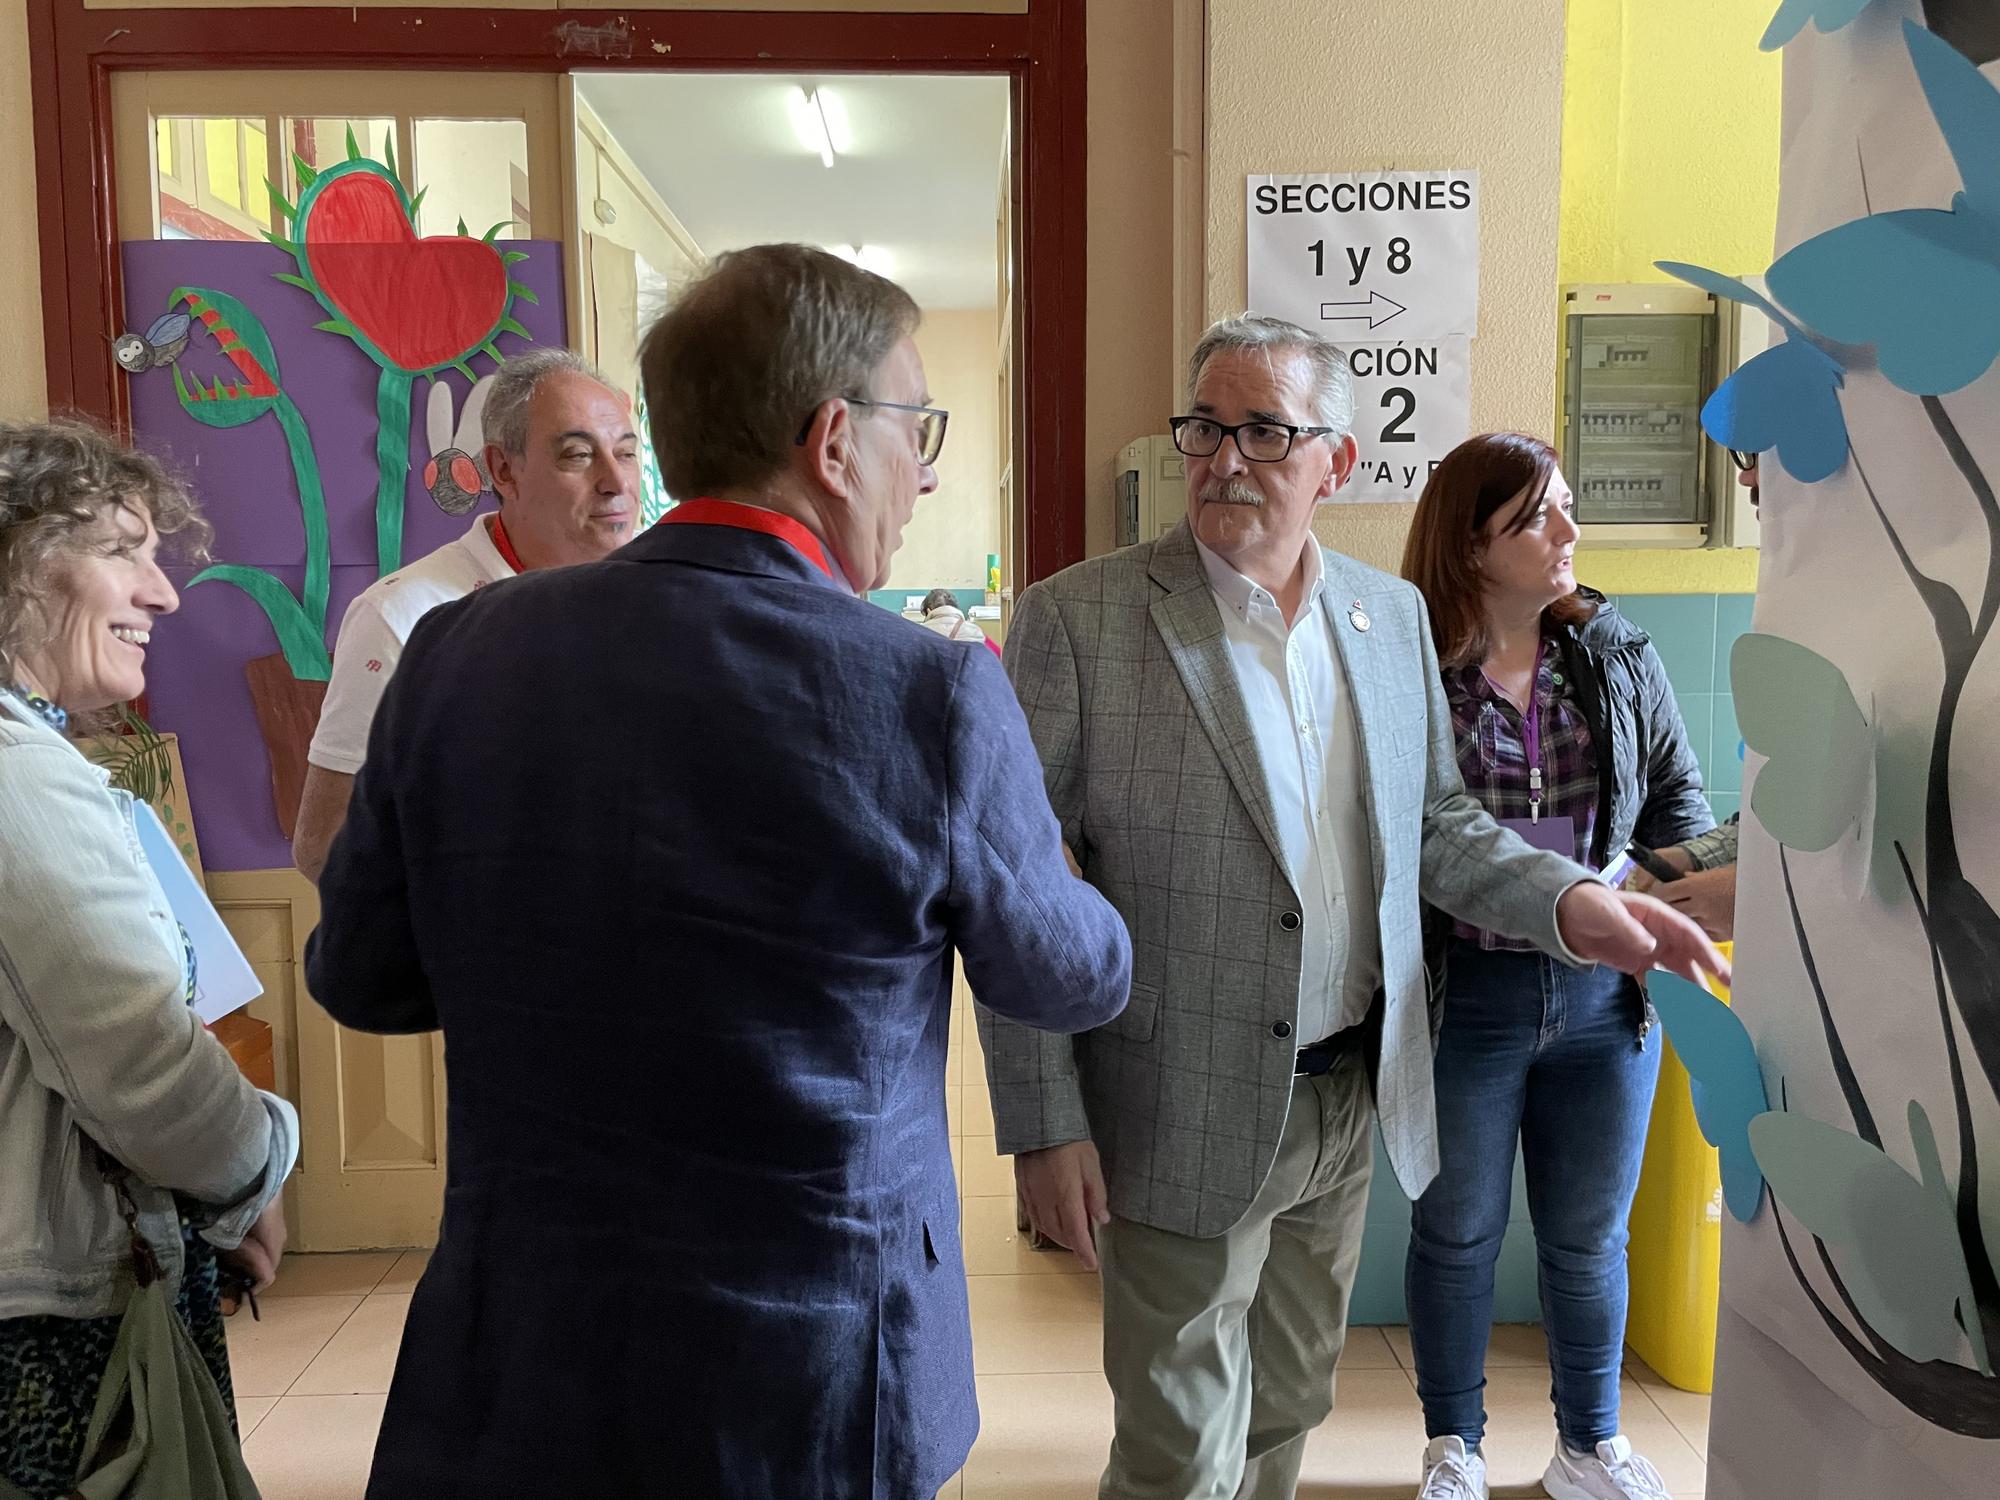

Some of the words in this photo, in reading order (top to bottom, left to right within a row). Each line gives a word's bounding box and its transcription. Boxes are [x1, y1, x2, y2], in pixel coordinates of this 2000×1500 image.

[1255, 180, 1471, 214] SECCIONES
[1307, 239, 1324, 276] 1
[1346, 246, 1371, 286] y
[1387, 237, 1412, 275] 8
[1349, 340, 1437, 377] CIÓN
[1380, 386, 1416, 443] 2
[1360, 460, 1393, 483] "A
[1402, 465, 1417, 489] y
